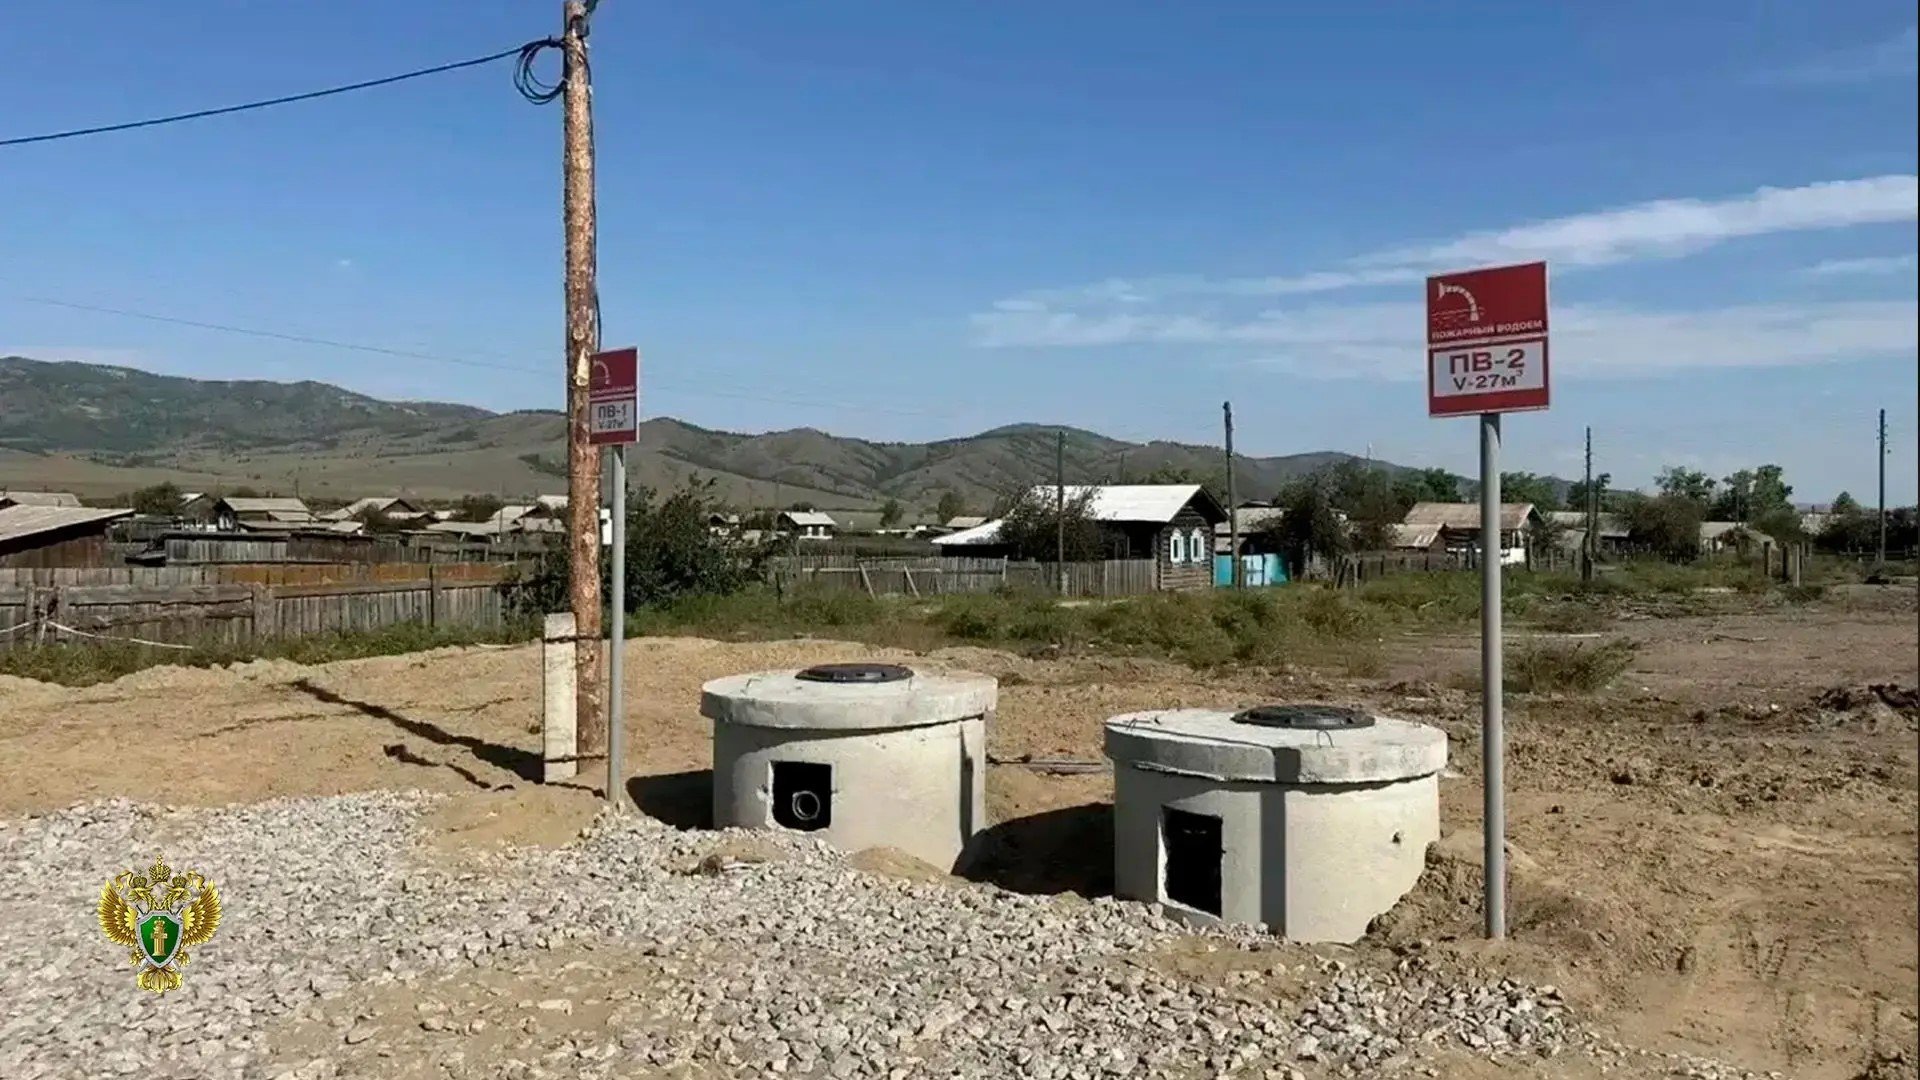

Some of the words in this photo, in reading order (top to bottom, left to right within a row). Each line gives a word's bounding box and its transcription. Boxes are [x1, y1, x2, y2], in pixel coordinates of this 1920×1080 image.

[1431, 326, 1495, 338] ПОЖАРНЫЙ
[1497, 320, 1543, 332] ВОДОЕМ
[1449, 348, 1525, 374] ПВ-2
[598, 403, 627, 418] ПВ-1
